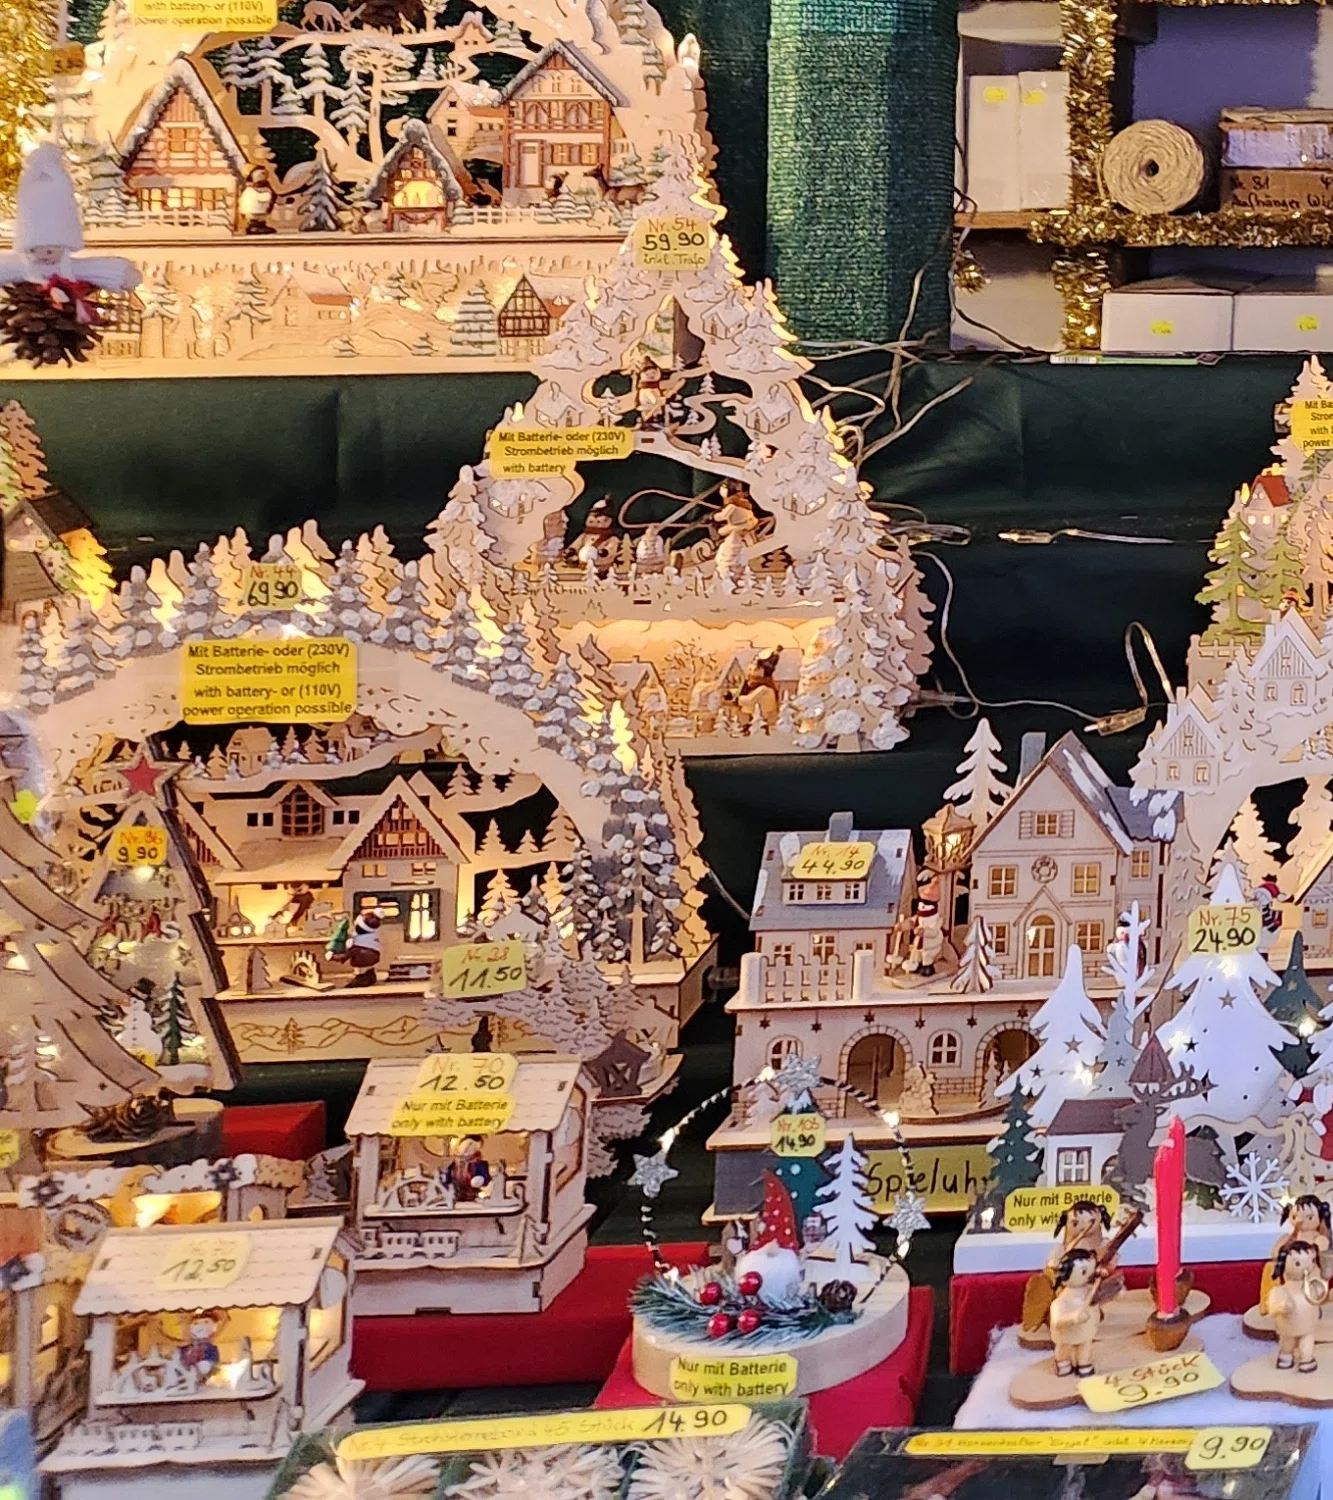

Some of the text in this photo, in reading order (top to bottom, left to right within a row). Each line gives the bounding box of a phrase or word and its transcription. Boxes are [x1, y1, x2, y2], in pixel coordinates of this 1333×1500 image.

[673, 217, 697, 232] 54
[642, 232, 705, 251] 59.90
[499, 431, 626, 444] Mit Batterie- oder (230V)
[505, 444, 619, 459] Strombetrieb möglich
[503, 463, 567, 478] with battery
[247, 581, 300, 607] 69.90
[188, 643, 350, 659] Mit Batterie- oder (230V)
[195, 662, 340, 680] Strombetrieb möglich
[193, 684, 341, 702] with battery- or (110V)
[183, 702, 352, 718] power operation possible
[117, 846, 159, 863] 9.90
[802, 860, 865, 875] 44.90
[1199, 908, 1253, 927] Nr. 75
[1192, 928, 1256, 953] 24.90
[487, 947, 511, 962] 28
[449, 967, 522, 992] 11.50
[419, 1074, 505, 1092] 12.50
[775, 1134, 816, 1152] 14.90
[1013, 1191, 1112, 1208] Nur mit Batterie
[1009, 1213, 1036, 1228] only
[678, 1357, 788, 1373] Nur mit Batterie
[674, 1380, 789, 1396] only with battery
[1116, 1371, 1200, 1403] 9.90
[646, 1408, 730, 1435] 14.90
[1199, 1435, 1265, 1460] 9.90
